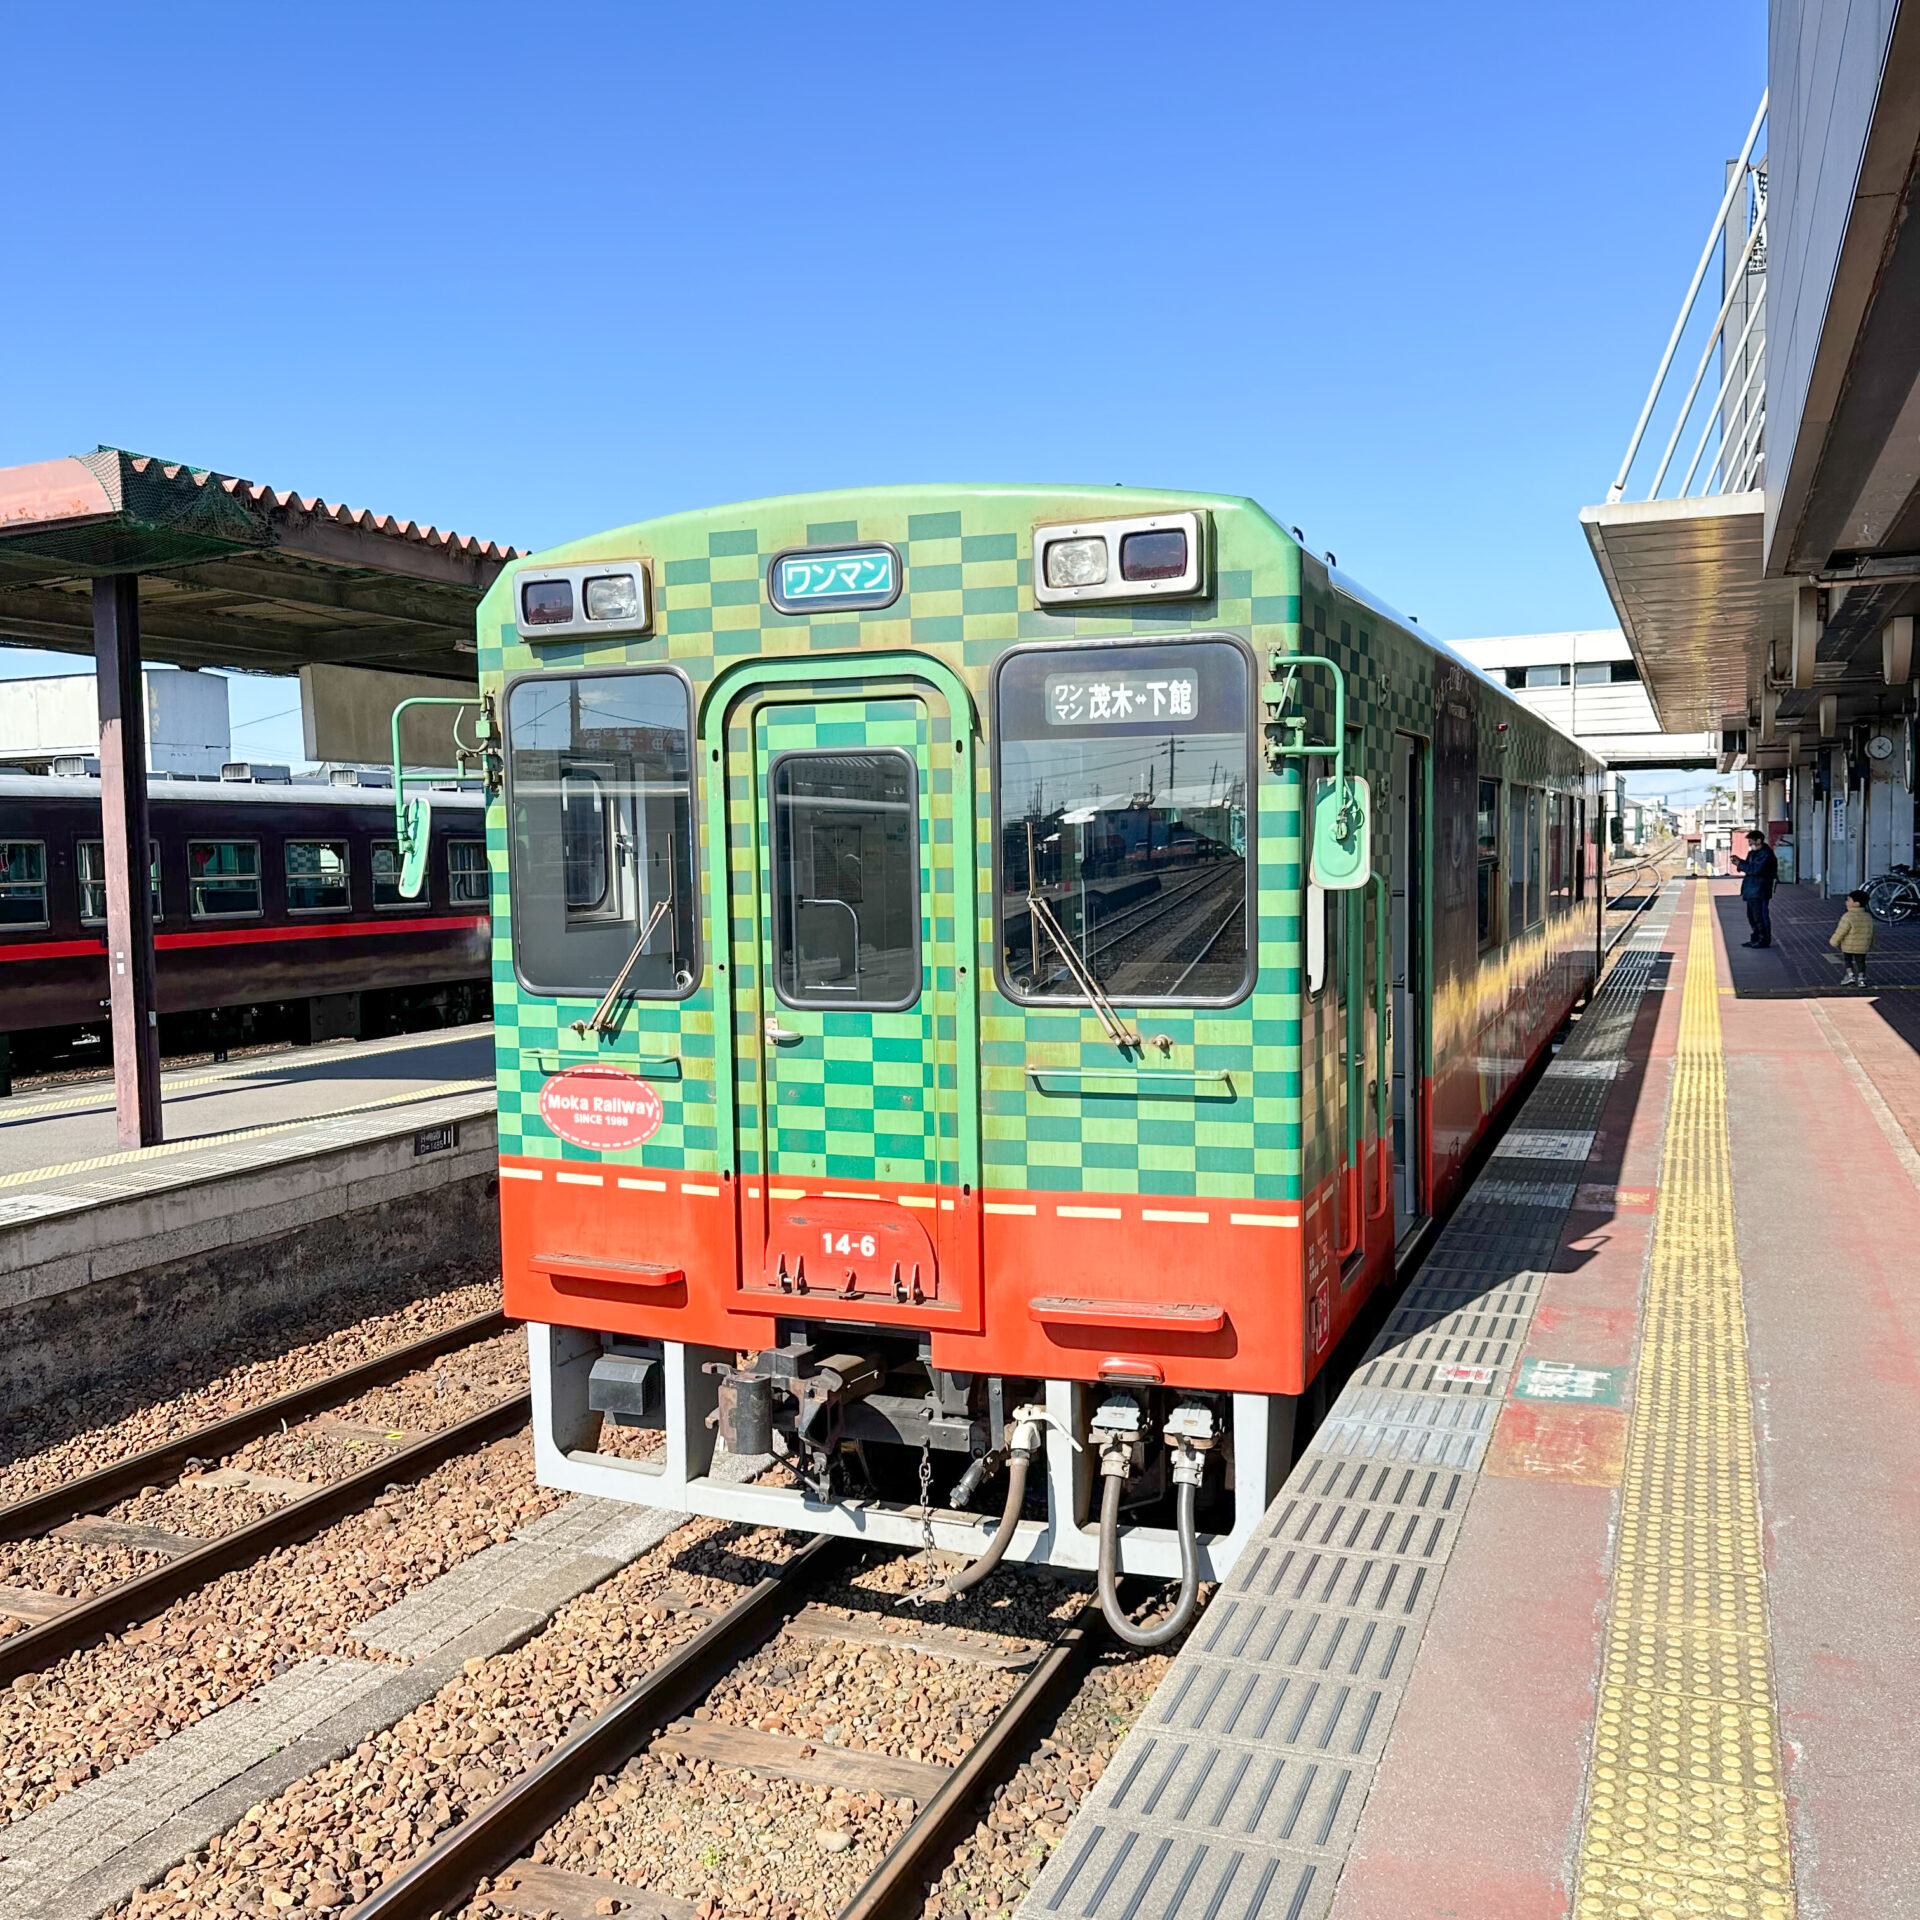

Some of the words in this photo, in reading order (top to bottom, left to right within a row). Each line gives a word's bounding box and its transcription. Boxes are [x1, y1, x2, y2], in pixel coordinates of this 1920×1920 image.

[787, 560, 888, 593] ワンマン
[1055, 684, 1083, 702] ワン
[1088, 682, 1133, 719] 茂木
[1146, 679, 1192, 716] 下館
[1055, 703, 1083, 720] マン
[547, 1094, 589, 1111] Moka
[593, 1097, 655, 1118] Railway
[573, 1113, 603, 1125] SINCE
[822, 1232, 876, 1257] 14-6
